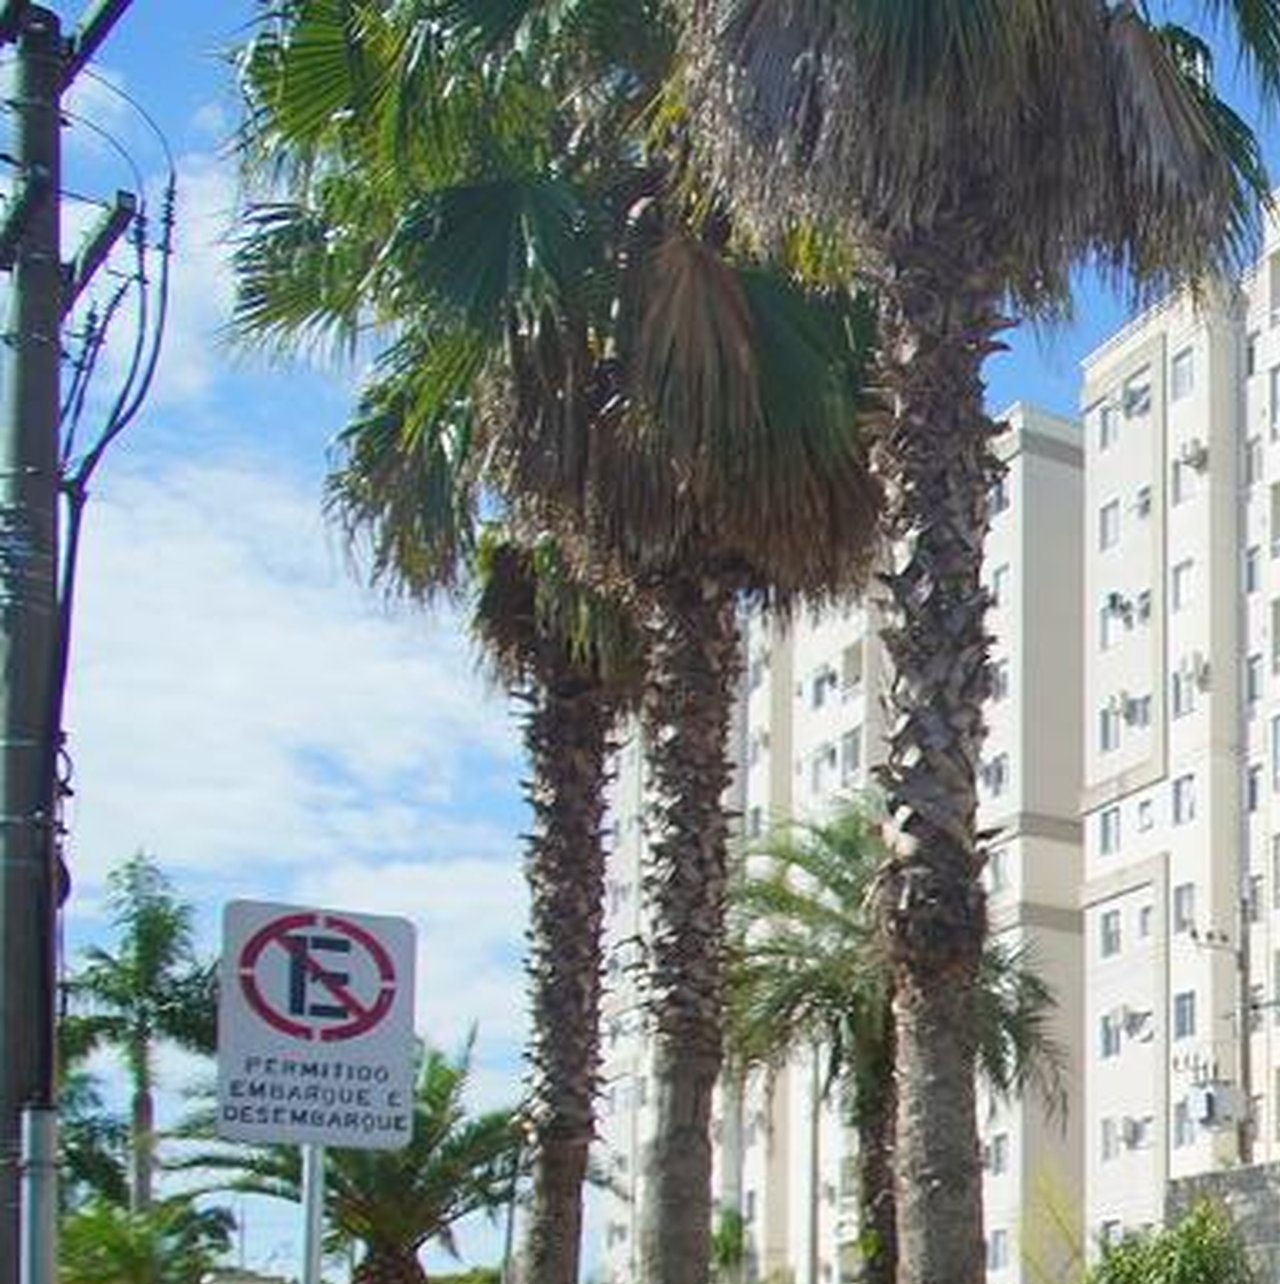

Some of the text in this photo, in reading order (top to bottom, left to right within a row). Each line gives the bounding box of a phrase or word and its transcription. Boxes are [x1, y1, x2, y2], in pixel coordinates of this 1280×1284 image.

[245, 1056, 389, 1084] PERMITIDO
[229, 1080, 403, 1109] EMBARQUE E
[222, 1105, 408, 1133] DESEMBARQUE
